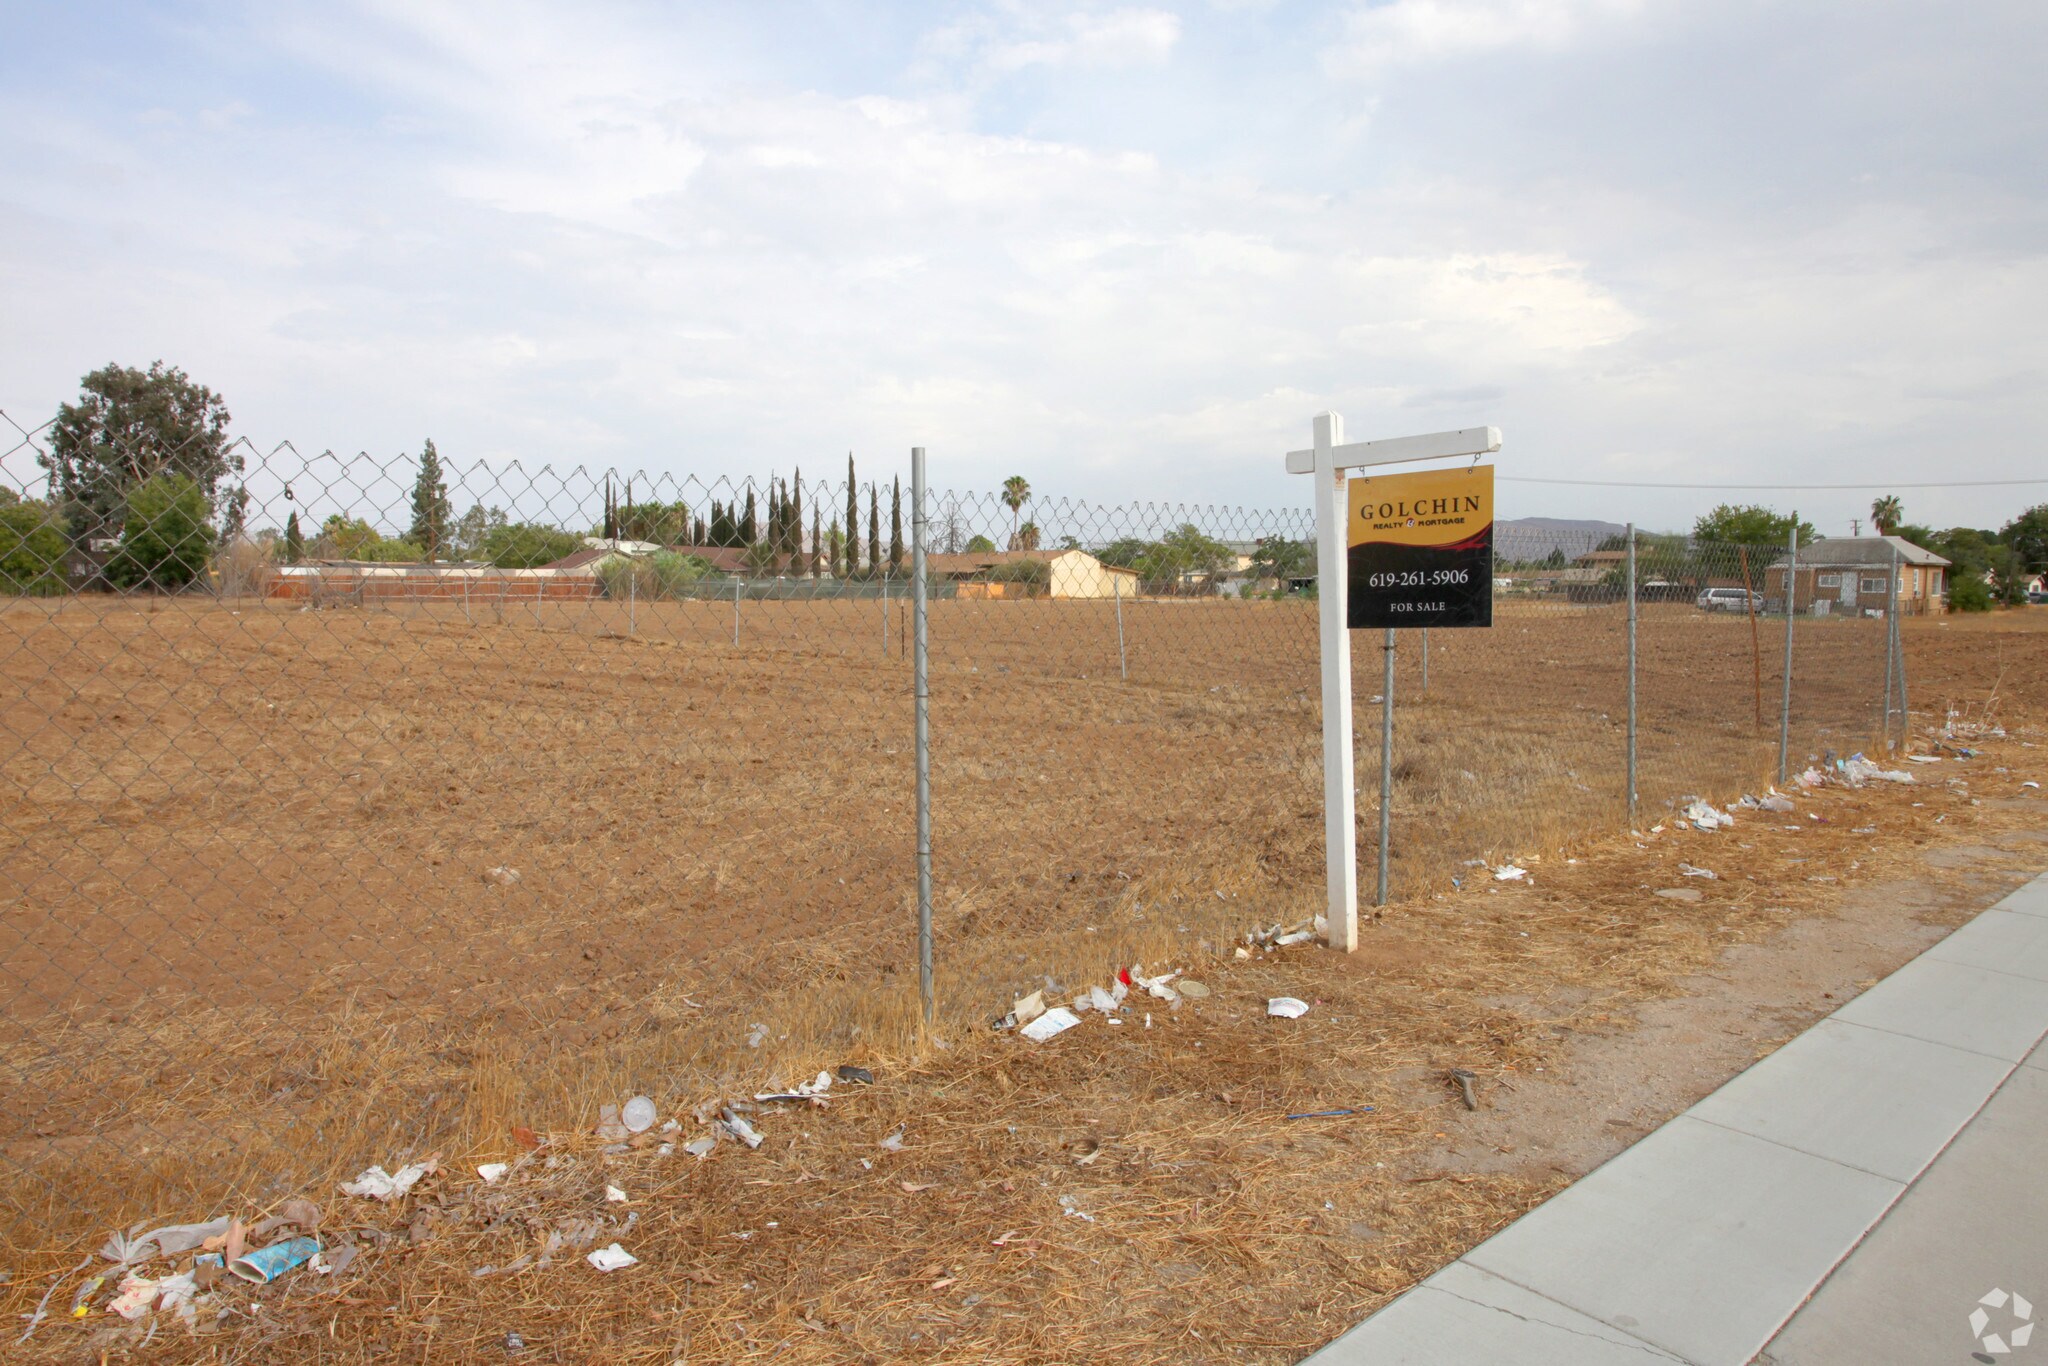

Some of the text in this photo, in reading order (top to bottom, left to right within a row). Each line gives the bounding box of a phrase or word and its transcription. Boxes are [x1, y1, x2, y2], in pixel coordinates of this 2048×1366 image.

[1361, 496, 1480, 520] GOLCHIN
[1373, 522, 1403, 530] REALTY
[1418, 518, 1465, 527] MORTGAGE
[1369, 569, 1469, 587] 619-261-5906
[1390, 602, 1446, 612] FOR SALE
